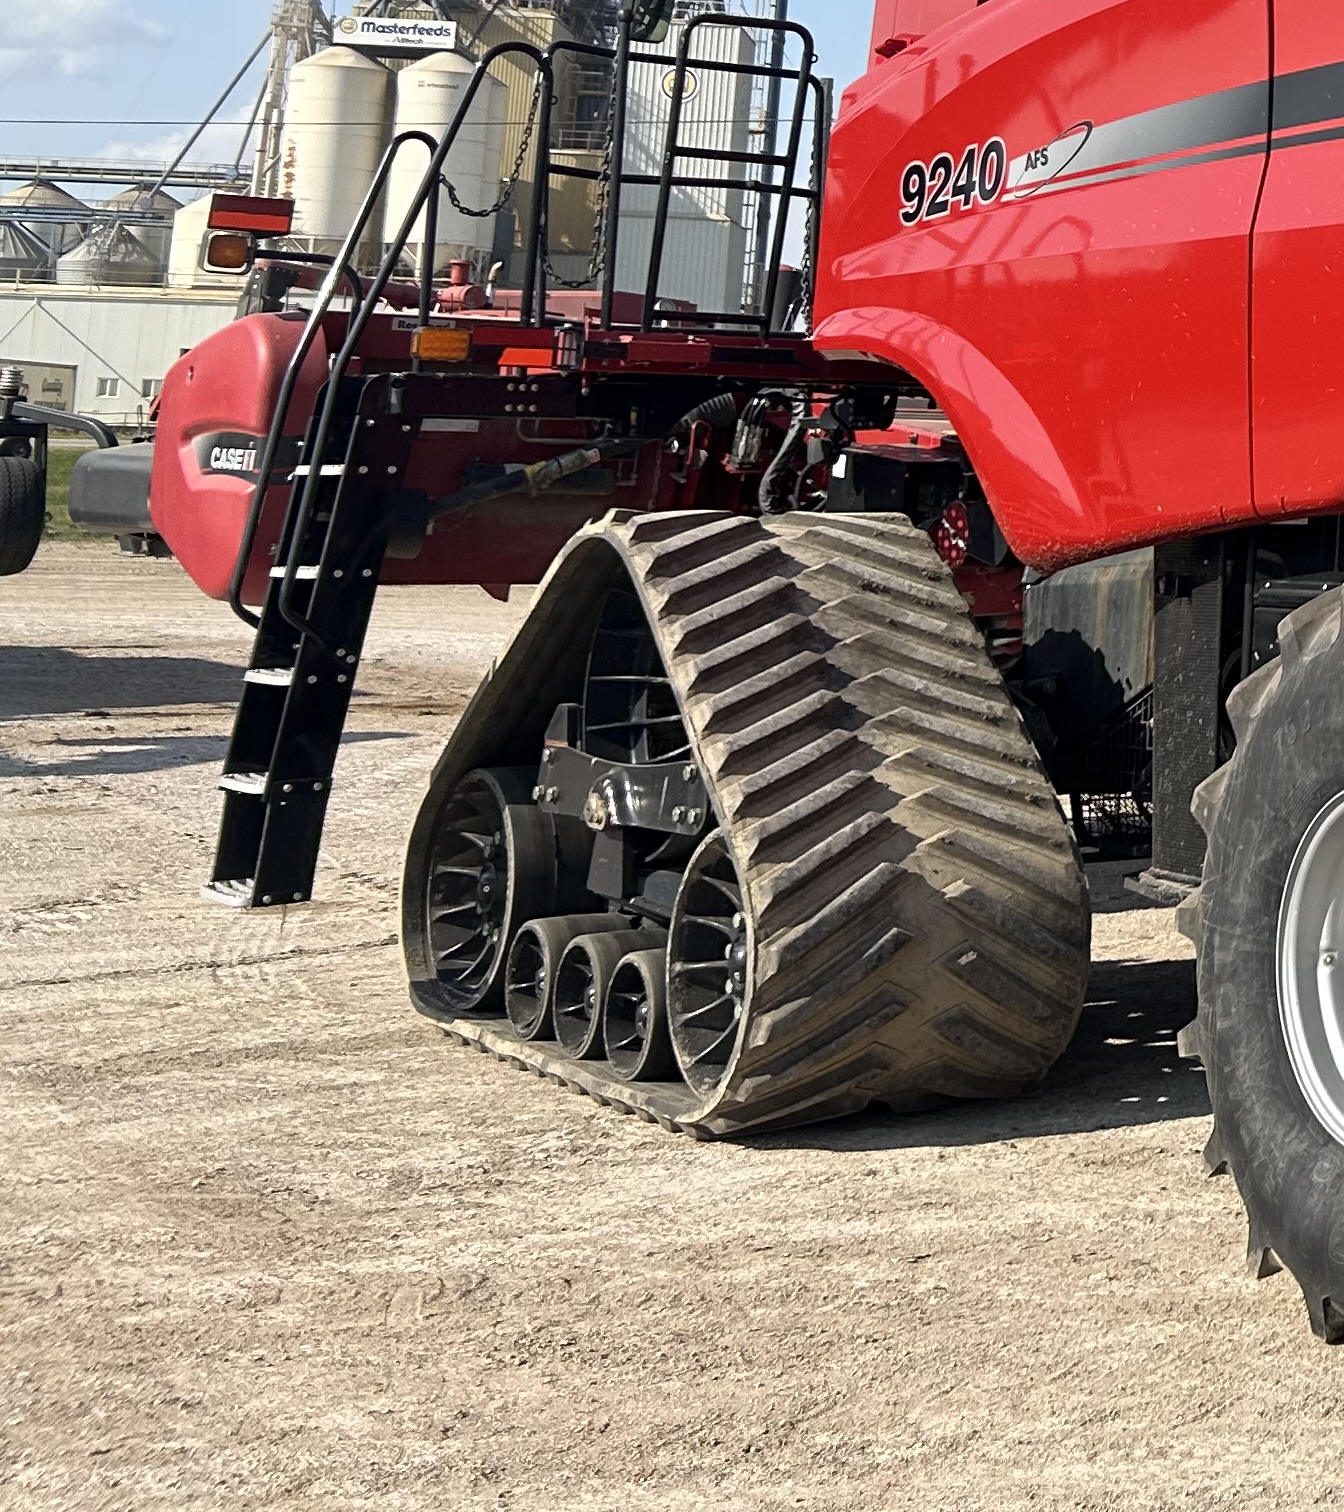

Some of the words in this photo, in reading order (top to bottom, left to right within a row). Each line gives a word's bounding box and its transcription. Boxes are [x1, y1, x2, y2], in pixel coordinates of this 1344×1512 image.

[361, 21, 451, 37] Masterfeeds
[901, 138, 1006, 225] 9240
[1024, 147, 1049, 172] AFS
[211, 447, 245, 471] CASE
